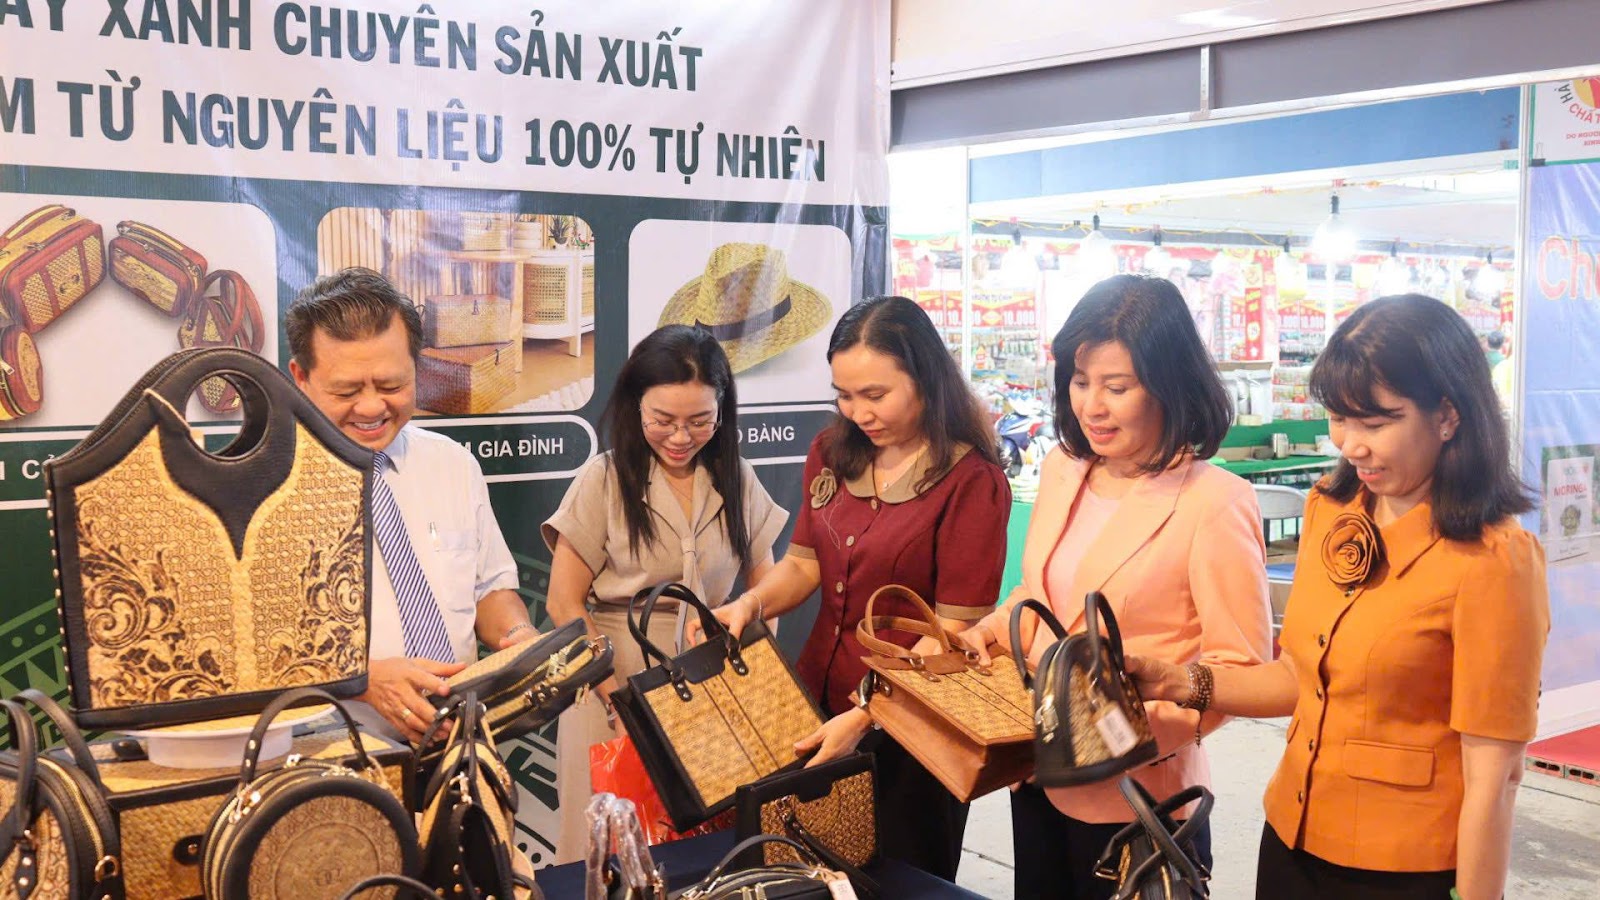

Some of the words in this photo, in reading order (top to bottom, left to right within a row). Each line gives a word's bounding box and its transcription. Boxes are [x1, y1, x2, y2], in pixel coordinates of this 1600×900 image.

[99, 0, 252, 51] XANH
[273, 3, 477, 71] CHUYÊN
[494, 10, 582, 80] SẢN
[597, 27, 703, 91] XUẤT
[57, 70, 141, 141] TỪ
[162, 88, 376, 155] NGUYÊN
[396, 98, 503, 171] LIỆU
[525, 118, 635, 171] 100%
[649, 121, 704, 184] TỰ
[717, 125, 826, 182] NHIÊN
[1537, 235, 1600, 300] Ch
[478, 440, 513, 458] GIA
[518, 434, 564, 456] ĐÌNH
[748, 423, 795, 443] BÀNG
